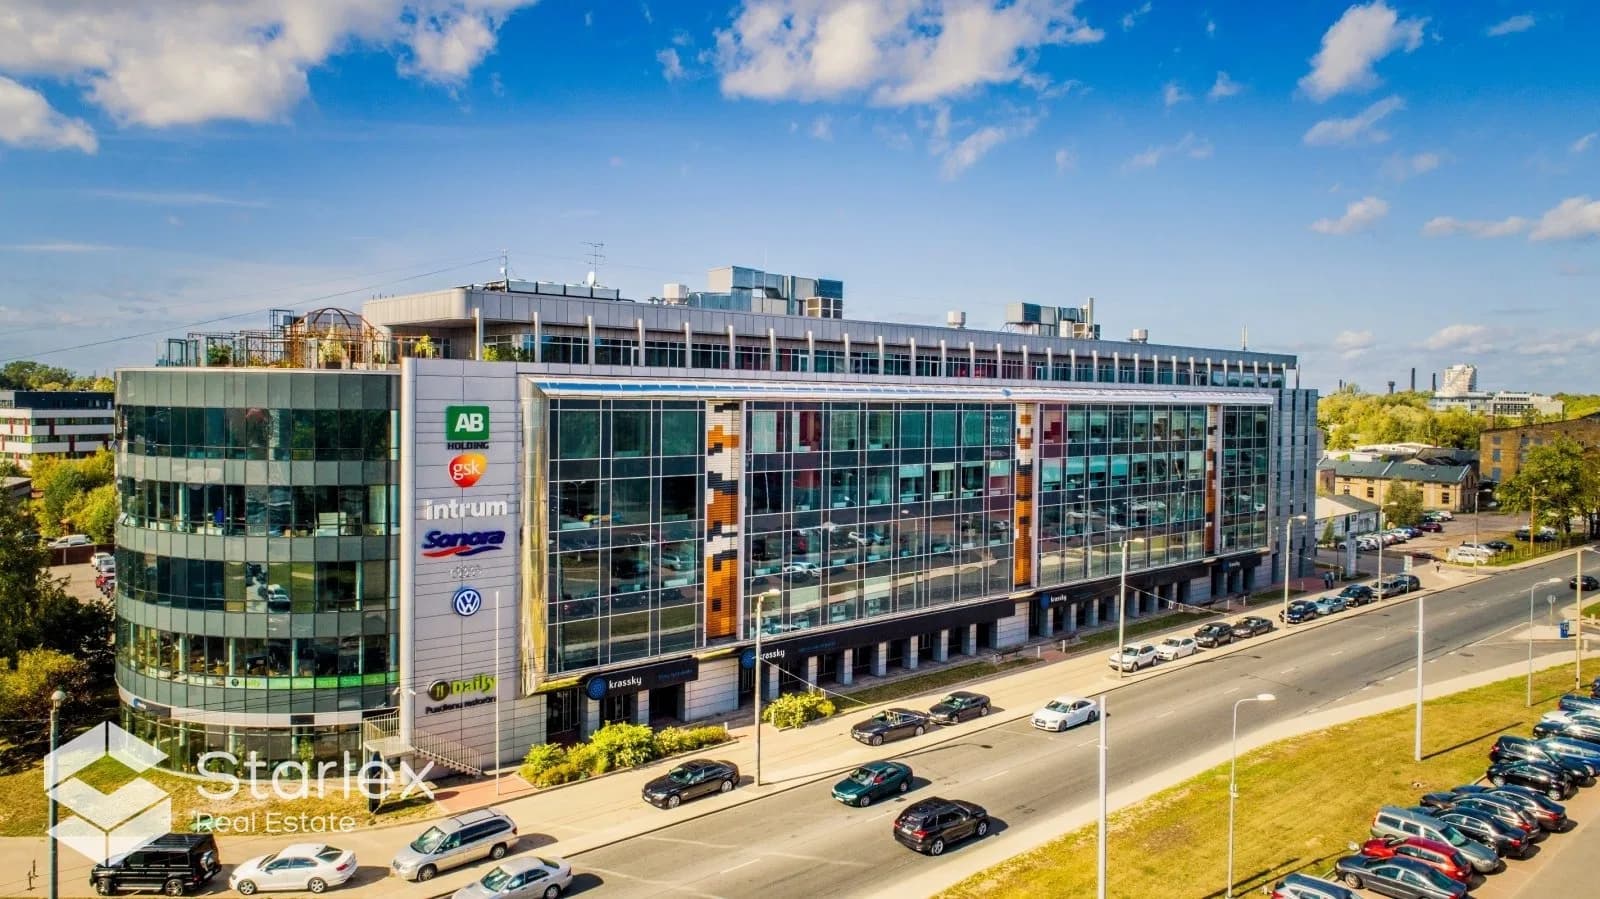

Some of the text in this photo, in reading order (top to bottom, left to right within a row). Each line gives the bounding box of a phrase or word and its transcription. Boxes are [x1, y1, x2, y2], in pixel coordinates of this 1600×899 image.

[454, 413, 484, 432] AB
[447, 442, 489, 450] HOLDING
[453, 460, 480, 480] gsk
[425, 499, 508, 520] intrum
[422, 531, 506, 549] Sonora
[451, 673, 496, 695] Daily
[608, 676, 642, 689] krassky
